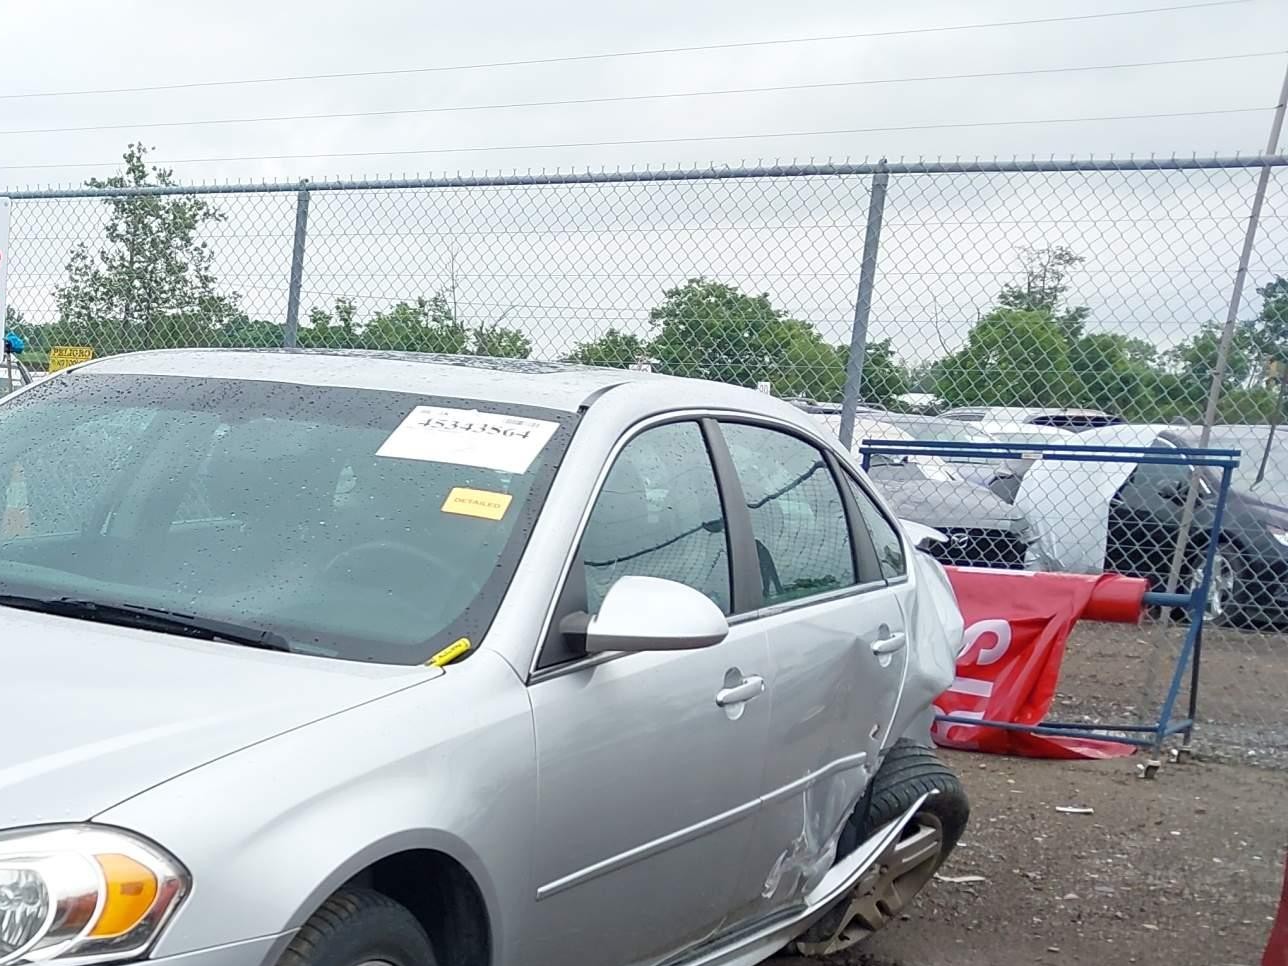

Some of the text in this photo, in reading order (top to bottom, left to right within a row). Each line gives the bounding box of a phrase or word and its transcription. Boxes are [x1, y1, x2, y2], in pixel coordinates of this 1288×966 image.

[53, 347, 92, 358] PELIGRO
[417, 412, 532, 440] 45343564
[454, 497, 501, 509] DETAILED
